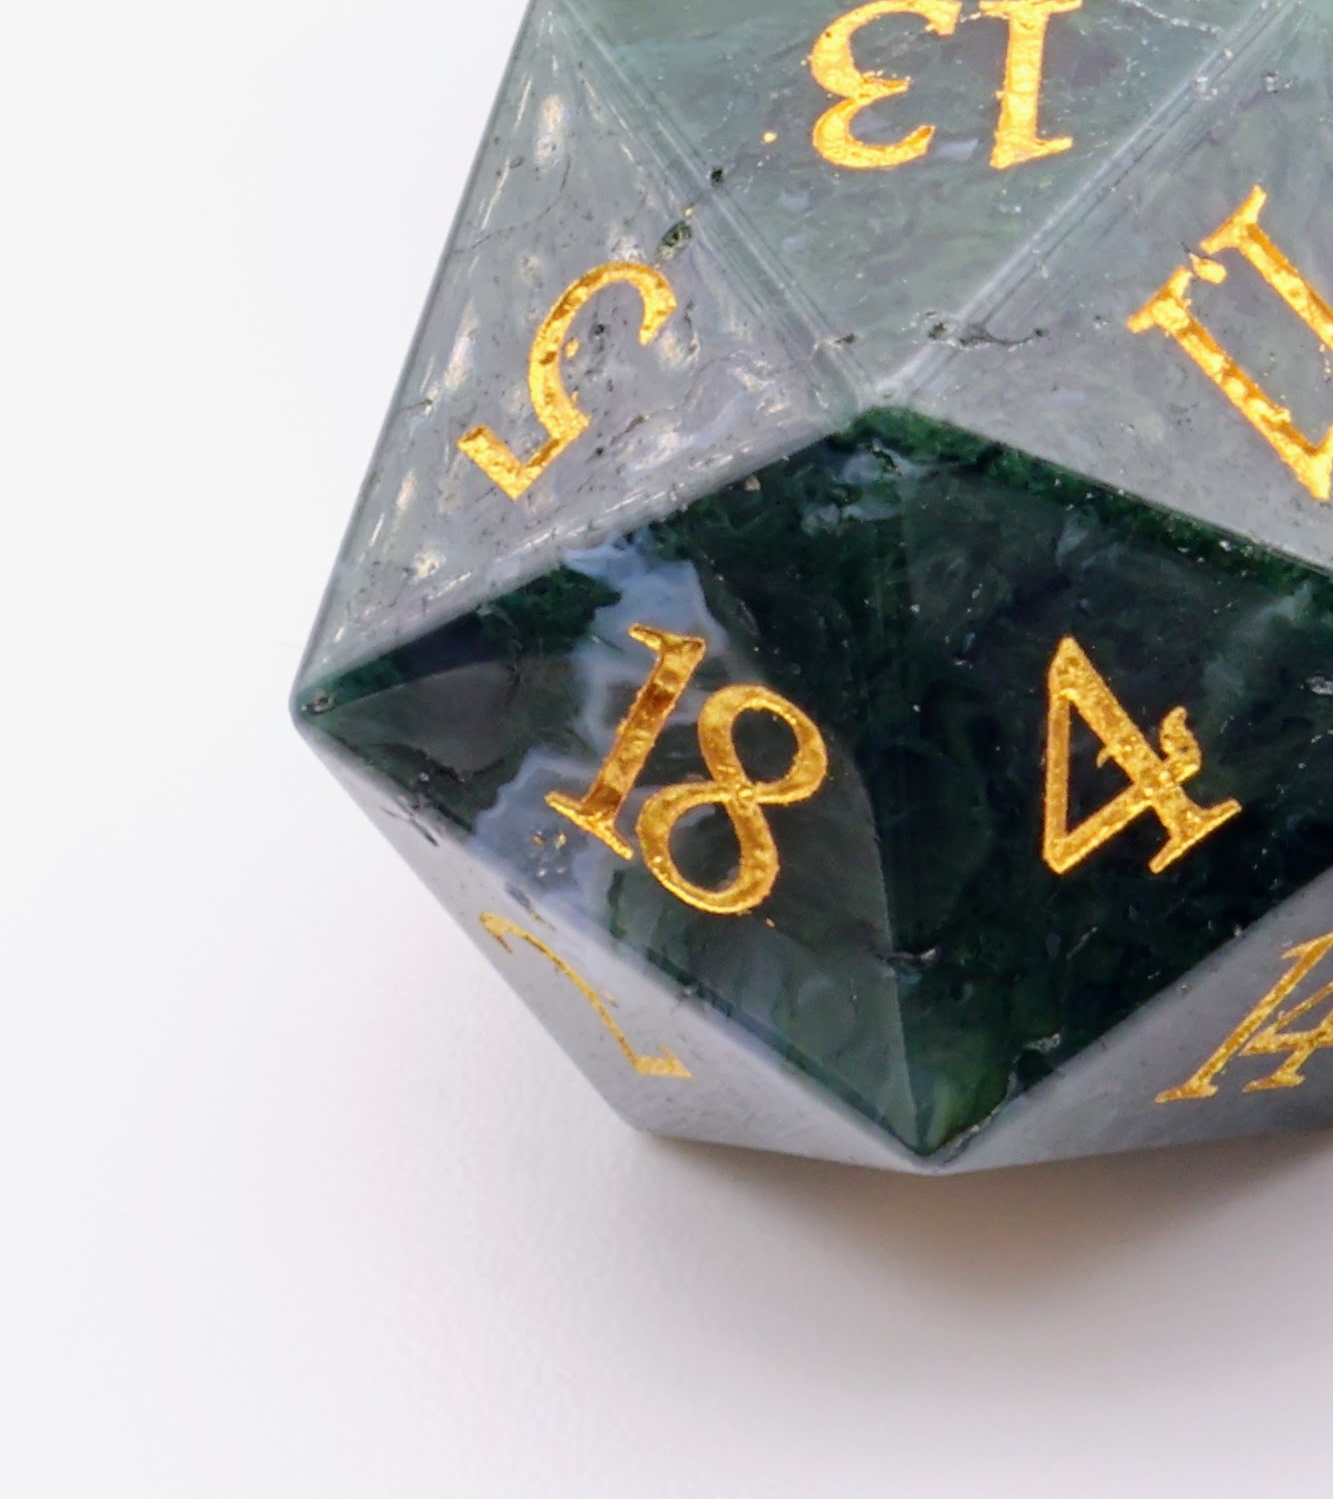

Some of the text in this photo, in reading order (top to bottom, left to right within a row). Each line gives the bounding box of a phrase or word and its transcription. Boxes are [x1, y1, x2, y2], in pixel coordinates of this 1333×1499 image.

[455, 258, 676, 498] 5
[545, 622, 831, 918] 18
[1040, 634, 1244, 877] 4
[480, 910, 692, 1080] 2
